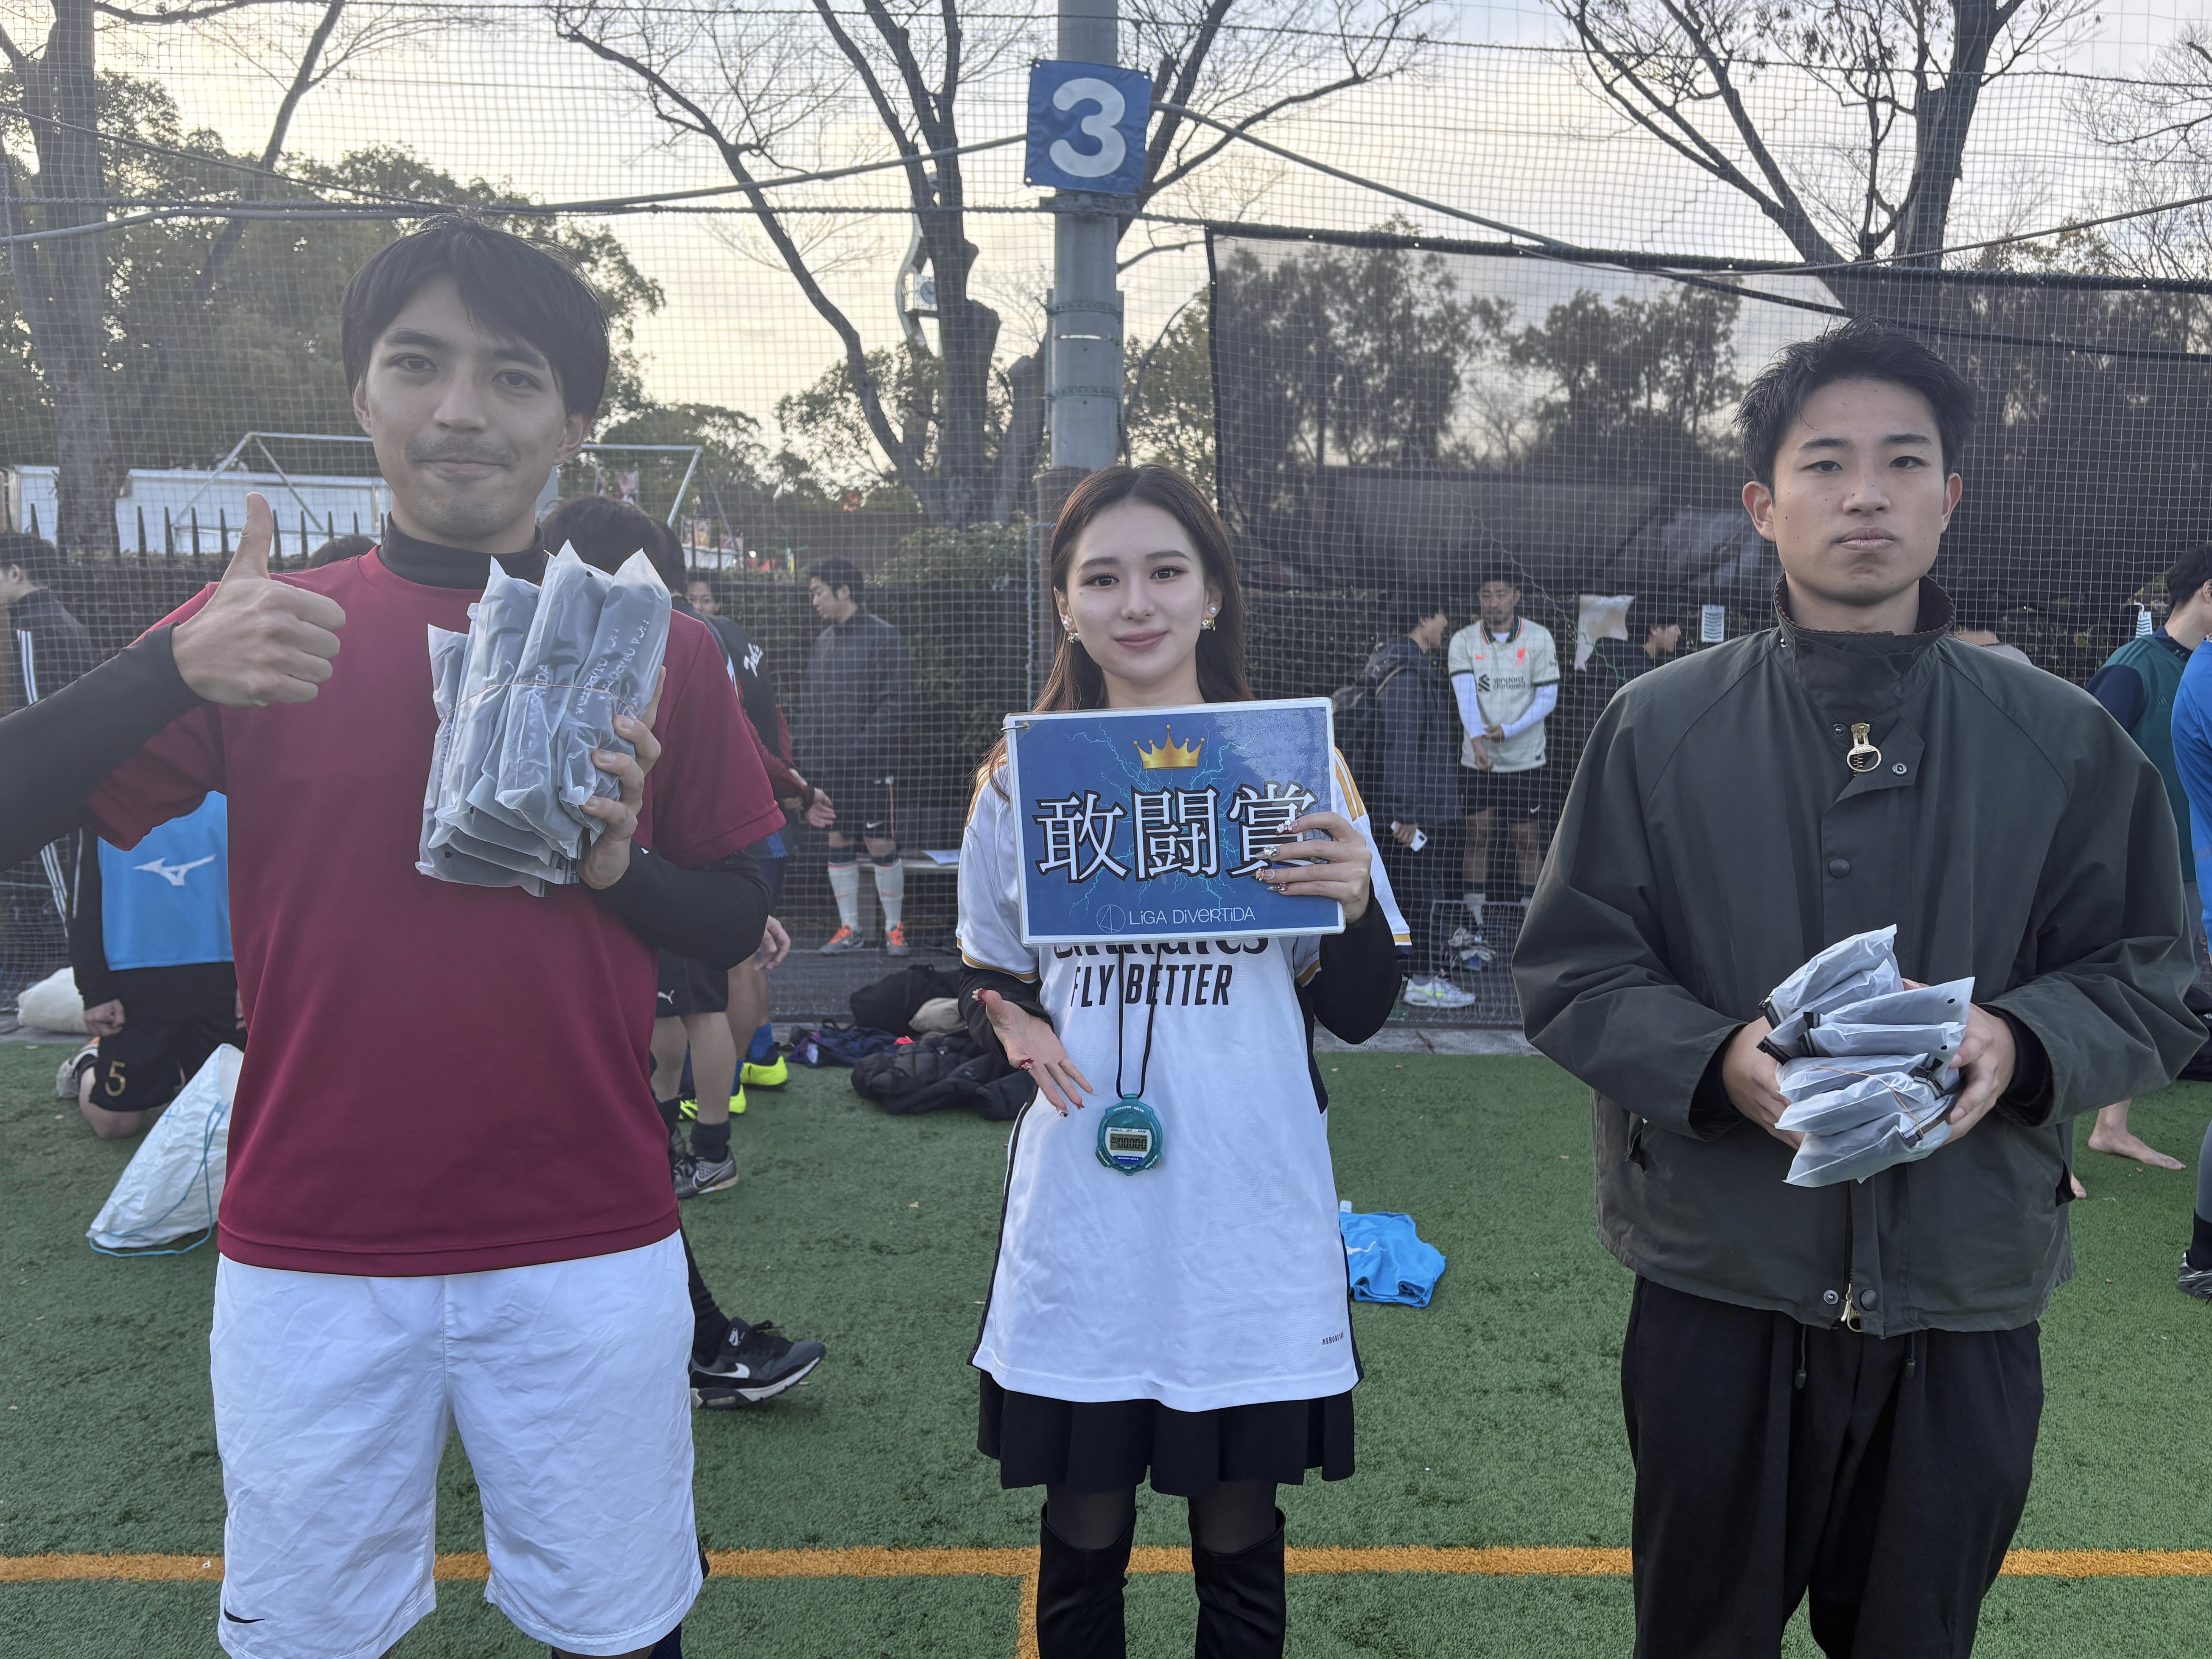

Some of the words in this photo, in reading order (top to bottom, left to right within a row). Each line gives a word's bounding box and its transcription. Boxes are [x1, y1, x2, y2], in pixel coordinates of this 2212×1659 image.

[1049, 78, 1126, 177] 3
[1032, 781, 1317, 884] 敢闘賞
[1125, 963, 1233, 1006] BETTER
[105, 1059, 126, 1098] 5
